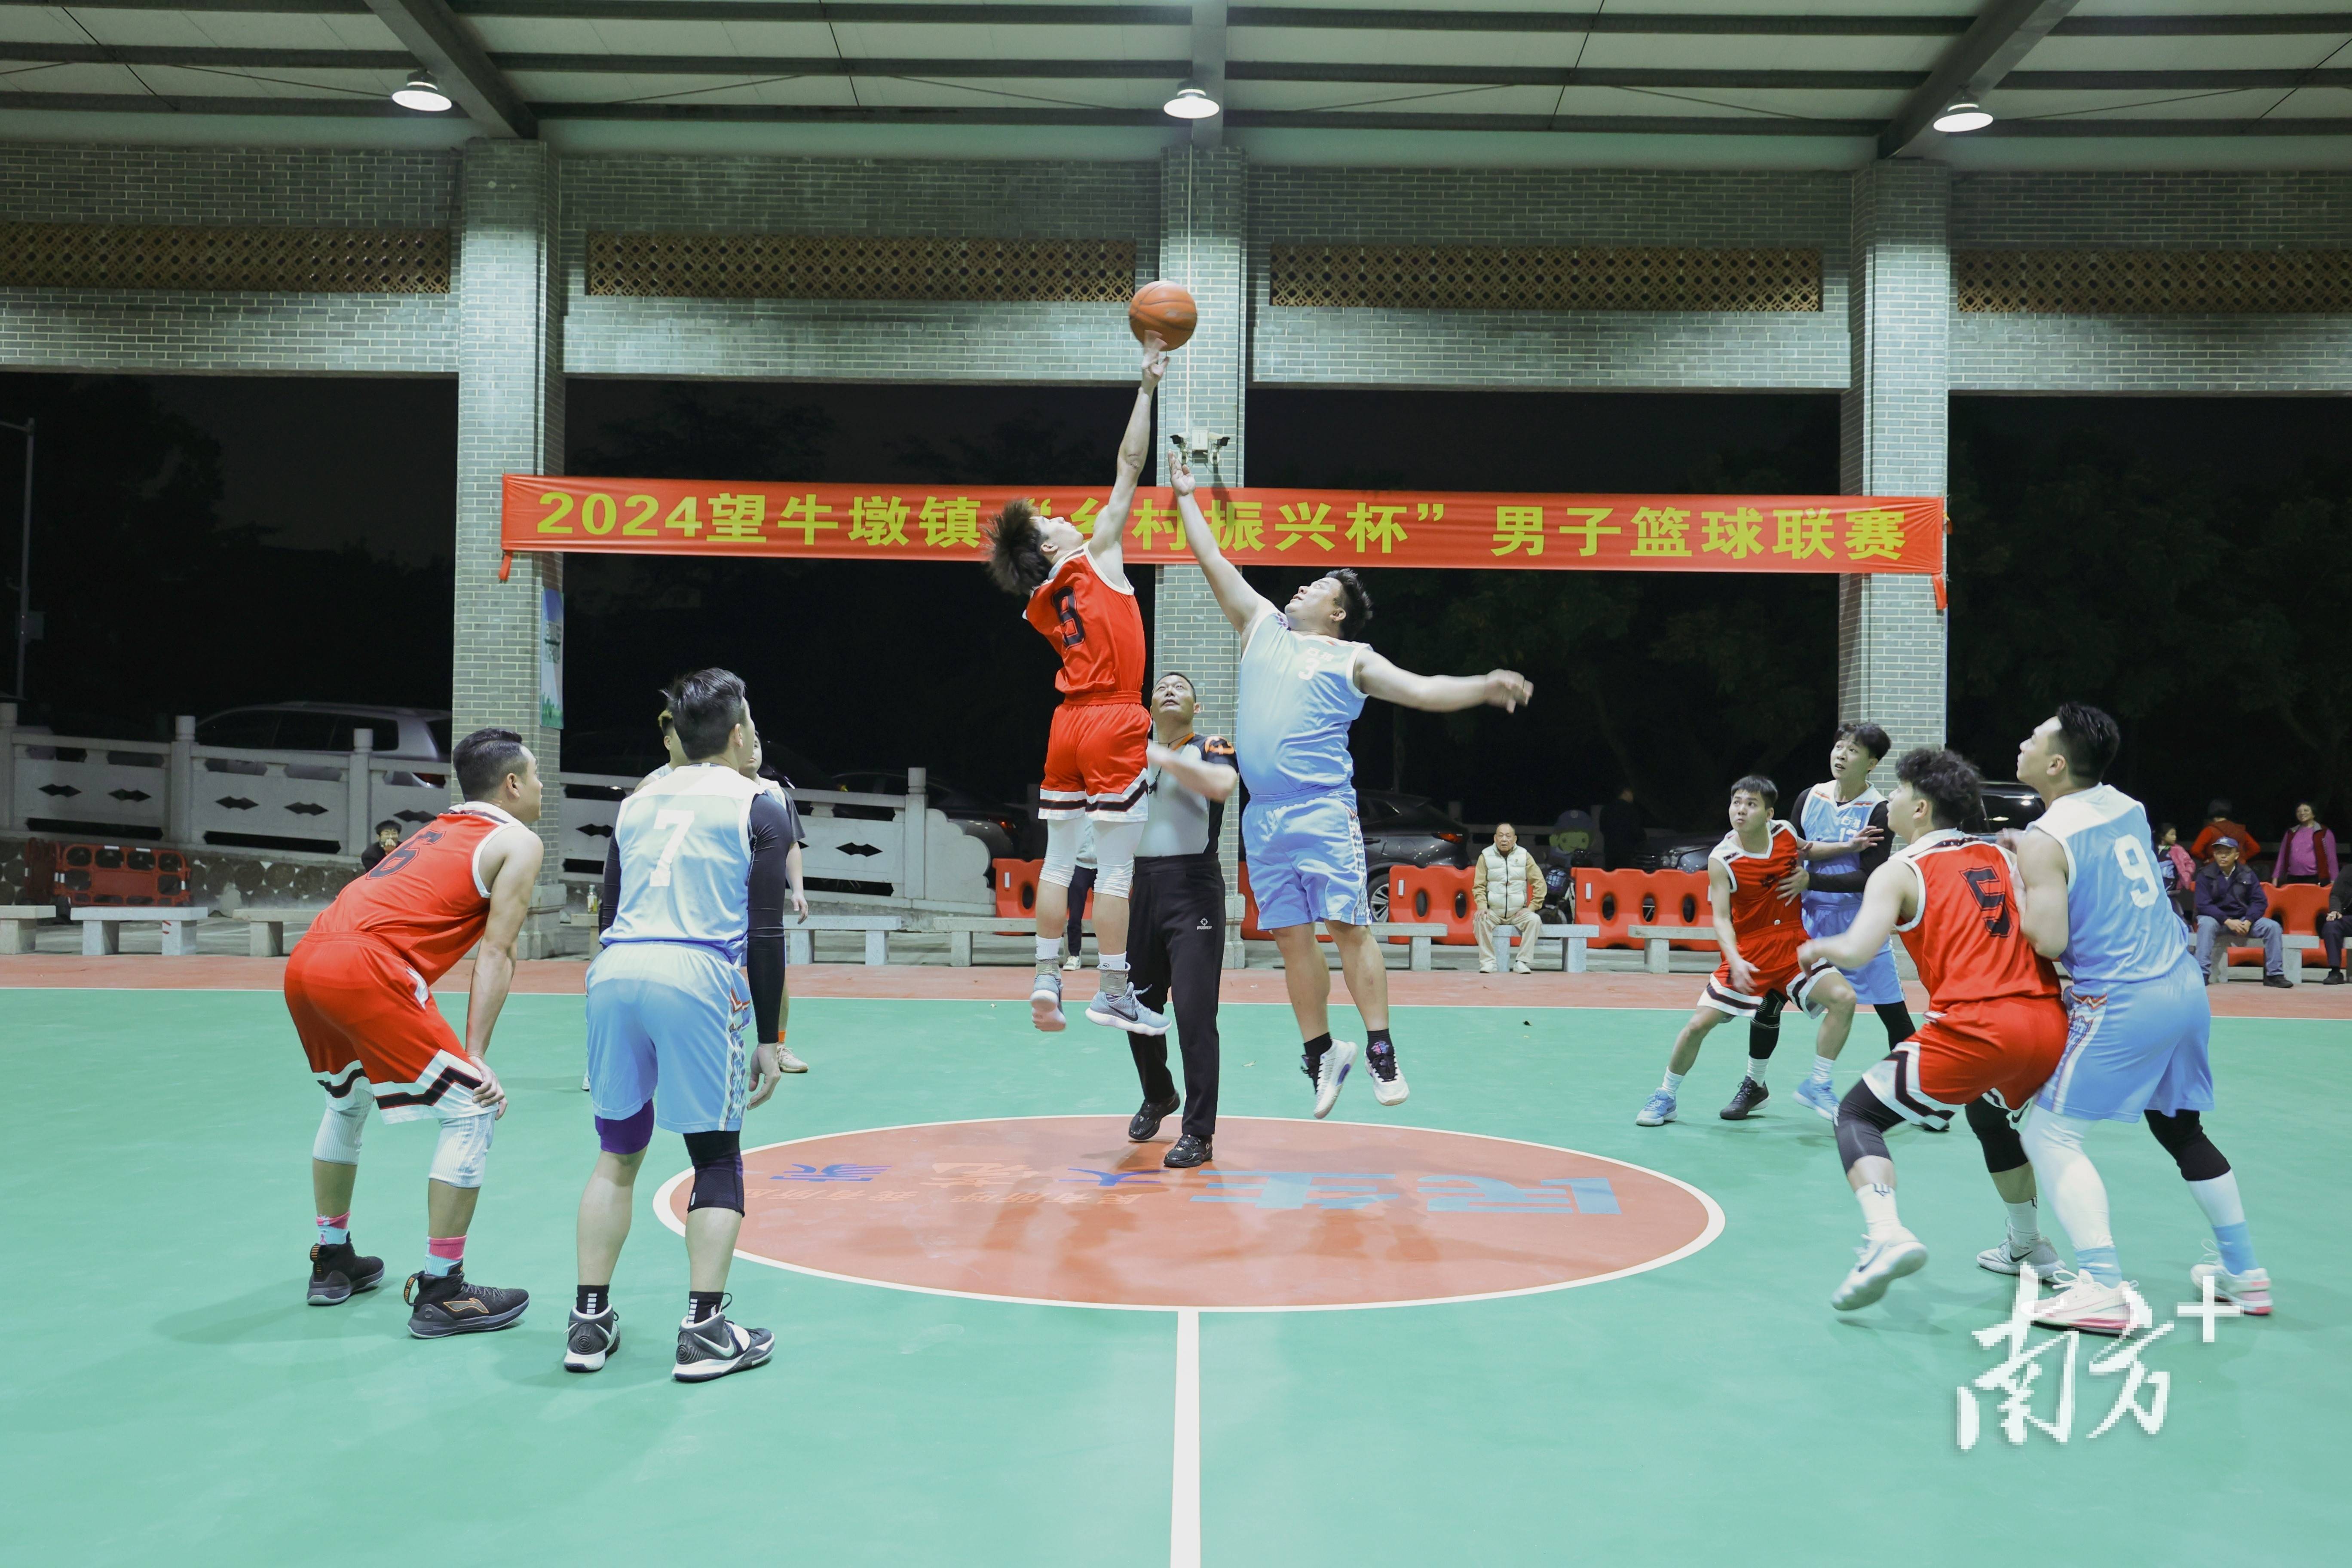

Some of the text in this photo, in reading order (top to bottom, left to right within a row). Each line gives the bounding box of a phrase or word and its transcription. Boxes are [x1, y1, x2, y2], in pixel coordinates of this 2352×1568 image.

[1298, 658, 1321, 681] 3
[365, 829, 446, 880] 6
[649, 809, 695, 887] 7
[2113, 834, 2160, 909] 9
[1959, 866, 2015, 938] 5
